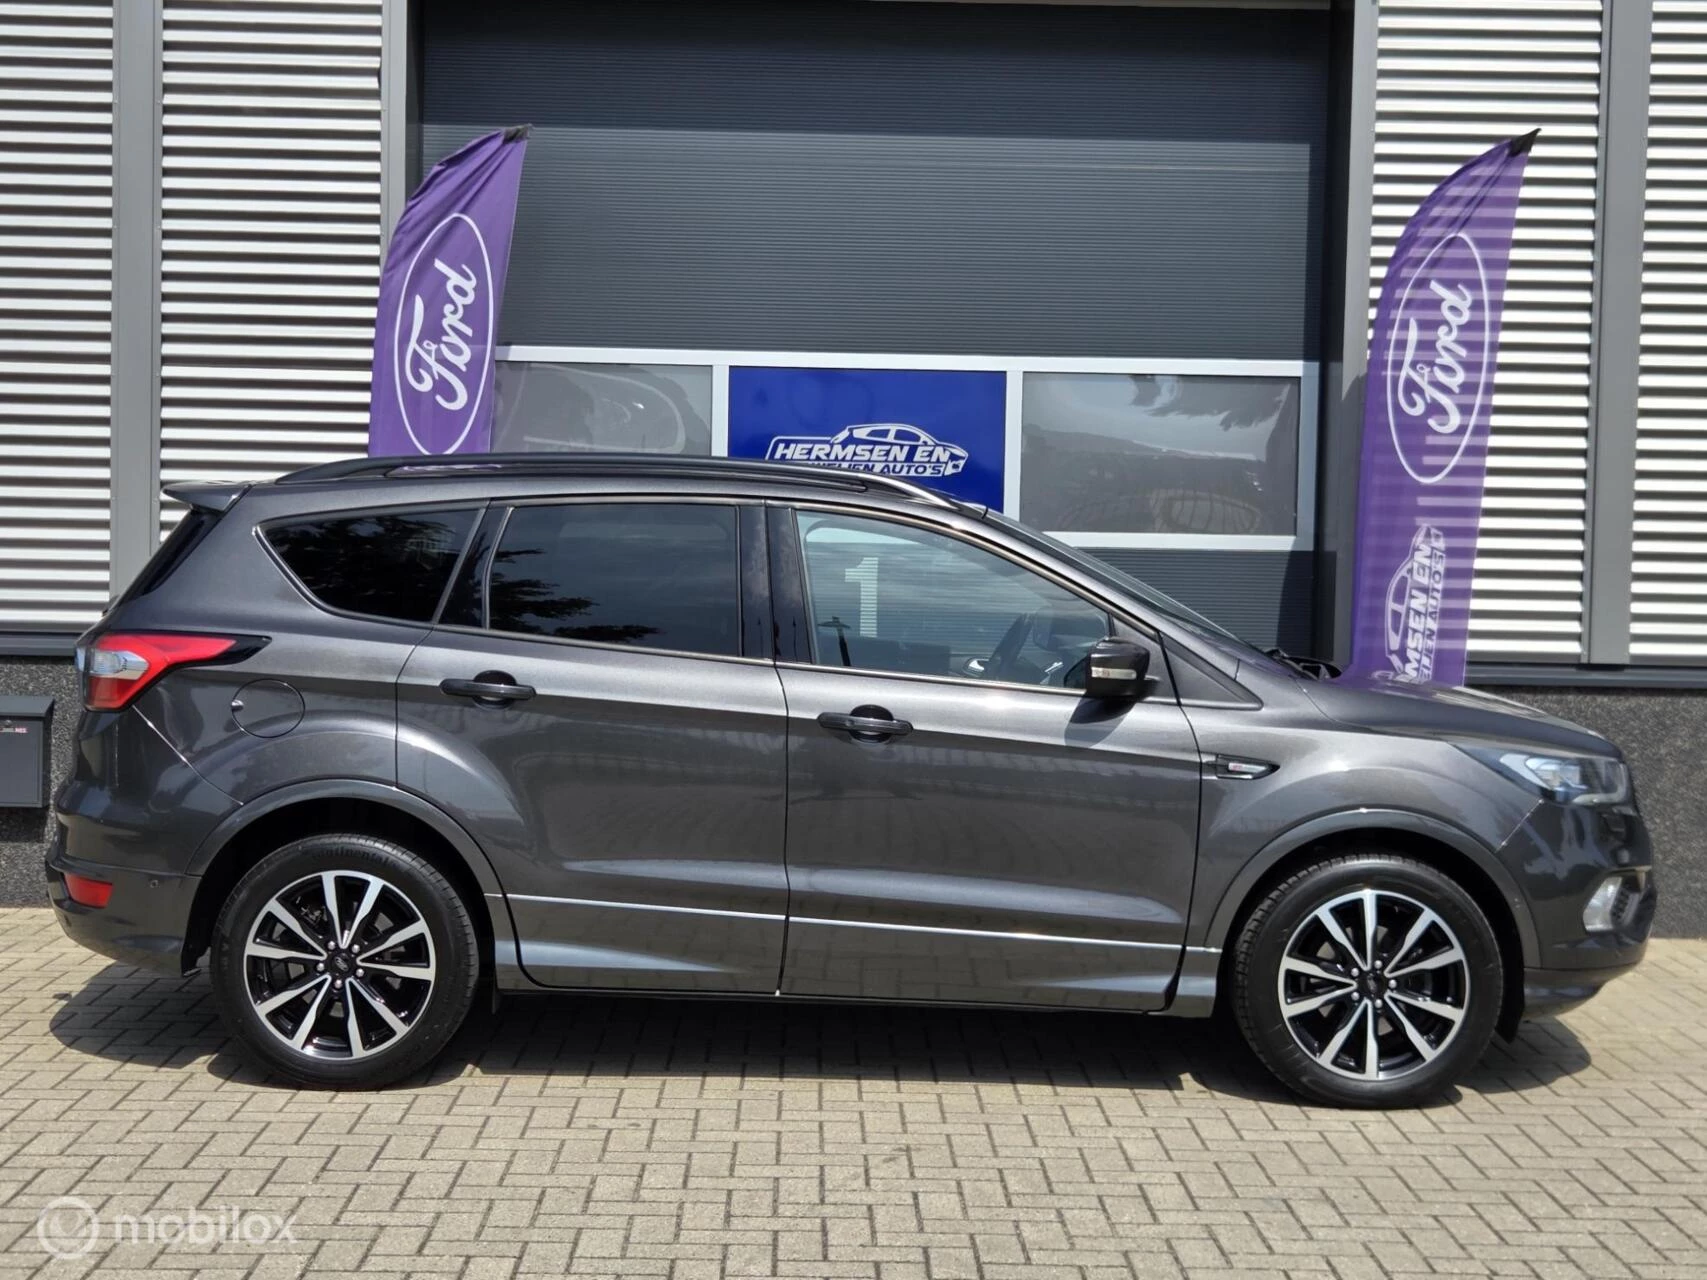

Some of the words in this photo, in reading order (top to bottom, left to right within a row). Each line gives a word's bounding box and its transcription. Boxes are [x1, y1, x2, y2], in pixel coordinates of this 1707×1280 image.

[405, 258, 477, 411] Ford
[1398, 280, 1472, 434] Ford
[774, 443, 909, 461] HERMSEN
[913, 445, 950, 462] EN
[880, 463, 944, 475] AUTO'S
[844, 557, 879, 637] 1
[1412, 543, 1433, 585] EN
[1404, 588, 1428, 678] MSEN
[1420, 627, 1436, 680] EIJEN
[1428, 552, 1443, 624] AUTO'S
